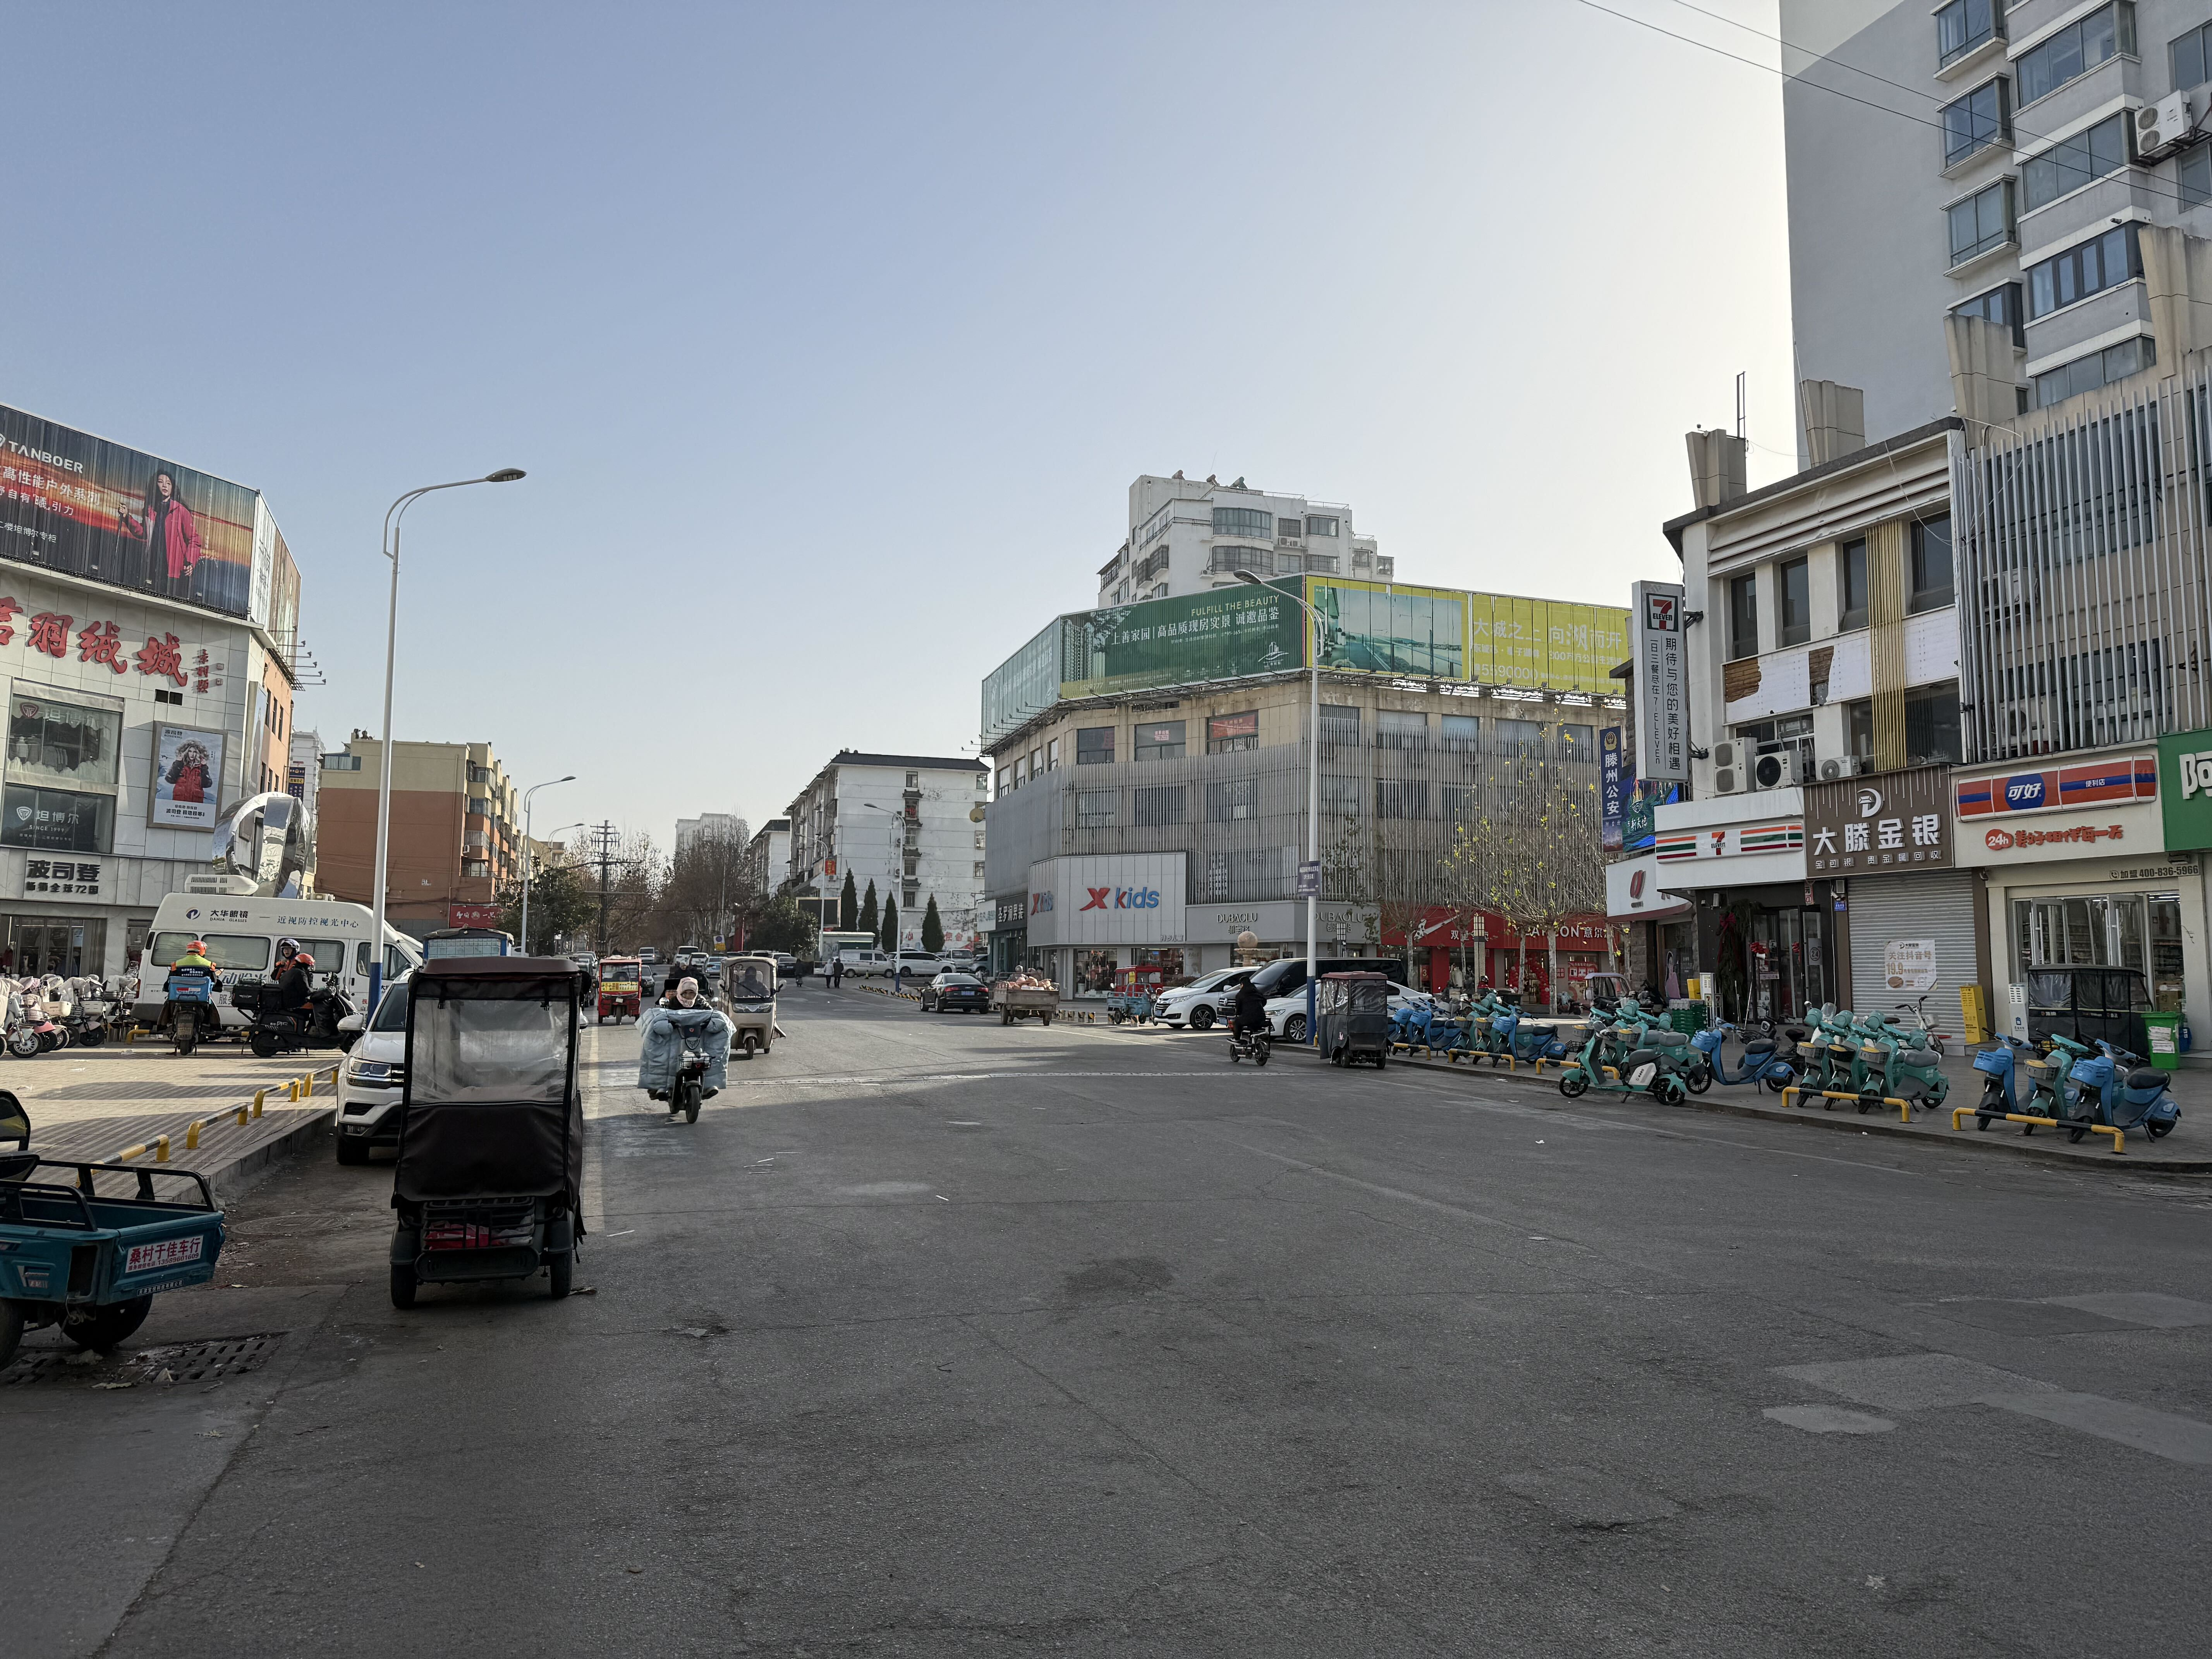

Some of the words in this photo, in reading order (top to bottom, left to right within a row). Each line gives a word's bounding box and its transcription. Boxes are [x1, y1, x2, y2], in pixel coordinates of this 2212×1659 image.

[9, 441, 83, 474] TANBOER
[3, 465, 100, 505] 高性能户外系列
[1191, 605, 1223, 617] FULFILL
[1225, 600, 1241, 611] THE
[1245, 594, 1279, 608] BEAUTY
[1653, 599, 1672, 630] 7
[1111, 627, 1150, 645] 上善家园
[1473, 618, 1542, 642] 大城之上
[1666, 637, 1681, 770] 期待与您的美好相遇
[1605, 752, 1620, 815] 滕州公安
[2008, 783, 2042, 800] 可好
[2085, 779, 2106, 787] 便利店
[36, 810, 79, 824] 坦博尔
[1712, 831, 1725, 855] 7
[1813, 814, 1941, 855] 大滕金银
[1988, 833, 2009, 847] 24h
[2015, 824, 2124, 848] 美好相伴每一天
[1867, 850, 1941, 865] 贵金属回收
[27, 860, 101, 882] 波司登
[2121, 869, 2138, 879] 加盟
[2139, 865, 2199, 878] 400-836-5966
[1114, 886, 1160, 909] kids
[210, 910, 249, 919] 大华眼镜
[277, 916, 359, 928] 近视防控视光中心
[1217, 912, 1258, 924] DUBAOLU
[1889, 950, 1932, 960] 关注抖音号
[1886, 962, 1904, 975] 19.9
